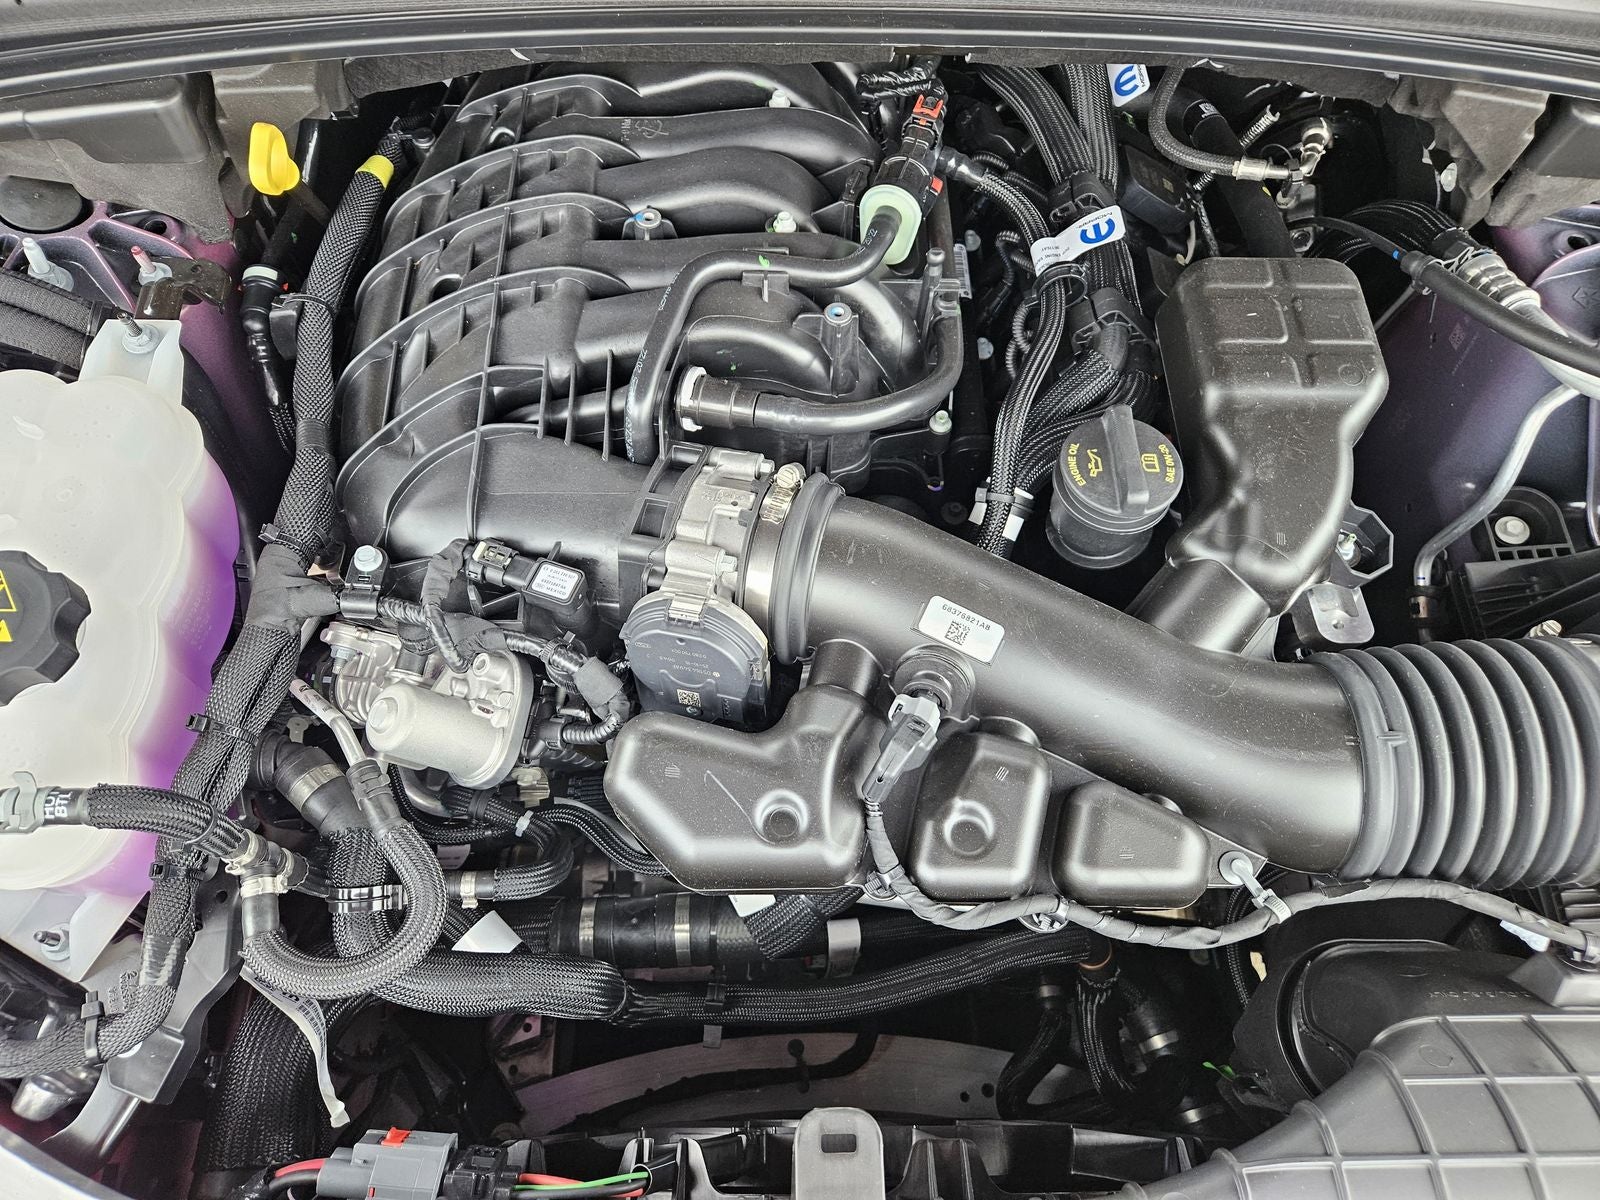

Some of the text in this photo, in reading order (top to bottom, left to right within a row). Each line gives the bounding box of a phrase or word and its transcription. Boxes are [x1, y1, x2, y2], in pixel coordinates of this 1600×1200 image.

[1067, 443, 1087, 486] ENGINE OIL
[1165, 466, 1175, 484] SAE
[941, 603, 991, 631] 68376821AB
